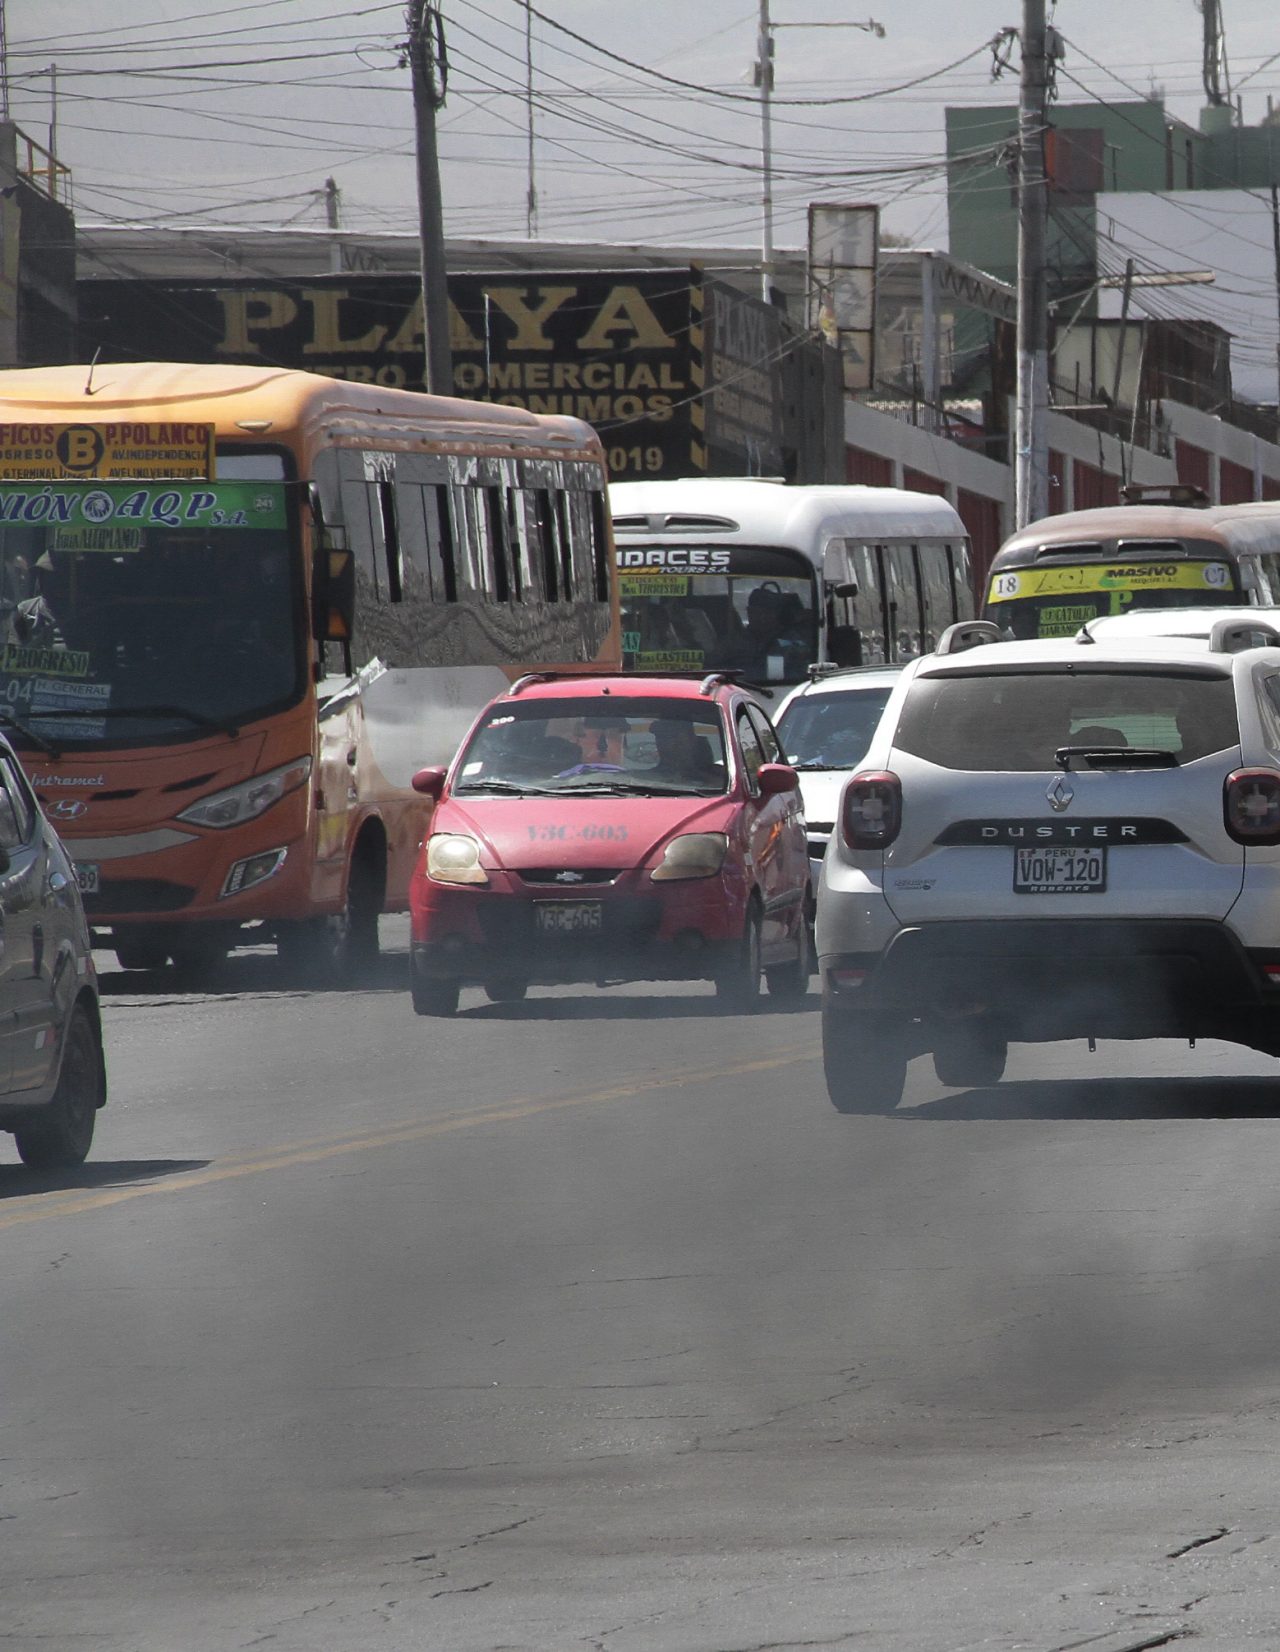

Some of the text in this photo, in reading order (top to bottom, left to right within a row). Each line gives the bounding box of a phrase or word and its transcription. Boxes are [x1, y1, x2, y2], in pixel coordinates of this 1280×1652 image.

[216, 285, 677, 353] PLAYA
[422, 362, 685, 391] OMERCIAL
[66, 429, 97, 466] B
[608, 446, 664, 471] 019
[1107, 565, 1178, 578] MASIVO
[1205, 567, 1226, 584] C7
[982, 826, 1137, 838] DUSTER
[1045, 848, 1076, 858] PERU
